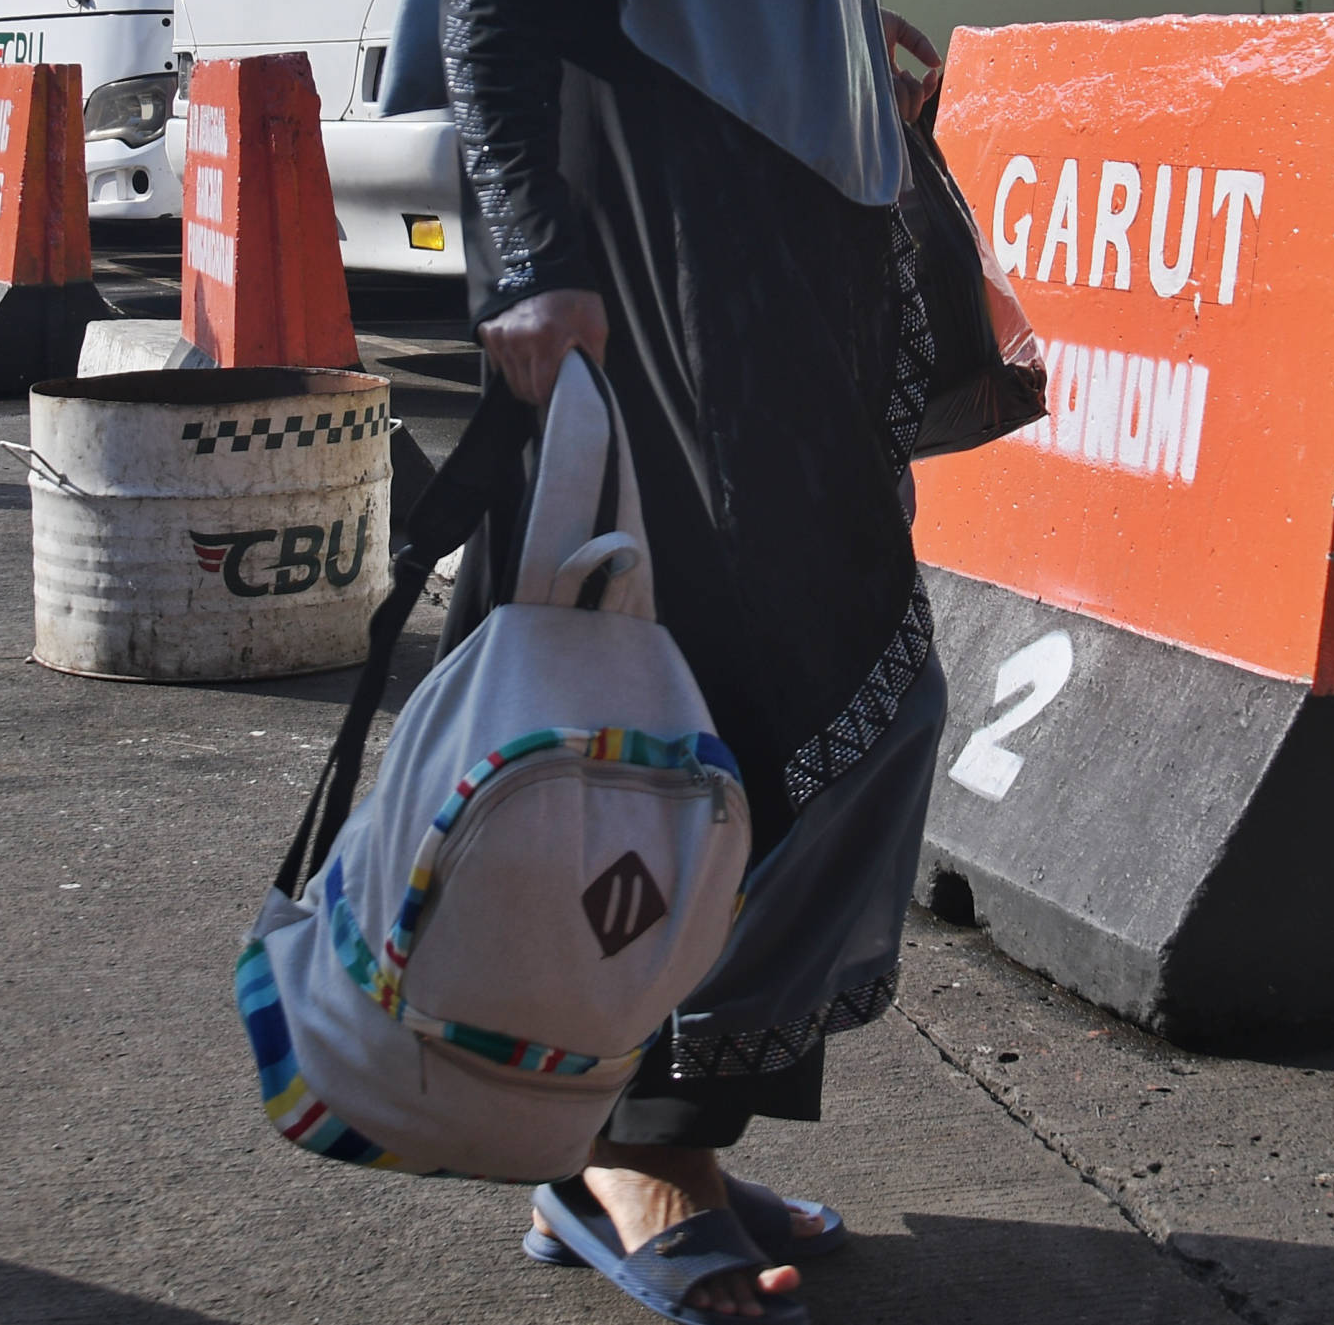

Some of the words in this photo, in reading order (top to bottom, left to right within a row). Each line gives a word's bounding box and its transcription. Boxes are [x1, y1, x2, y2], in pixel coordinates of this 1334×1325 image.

[992, 153, 1266, 306] GARUT
[1003, 337, 1210, 487] KONOMI
[189, 514, 368, 598] CBU
[948, 629, 1073, 802] 2
